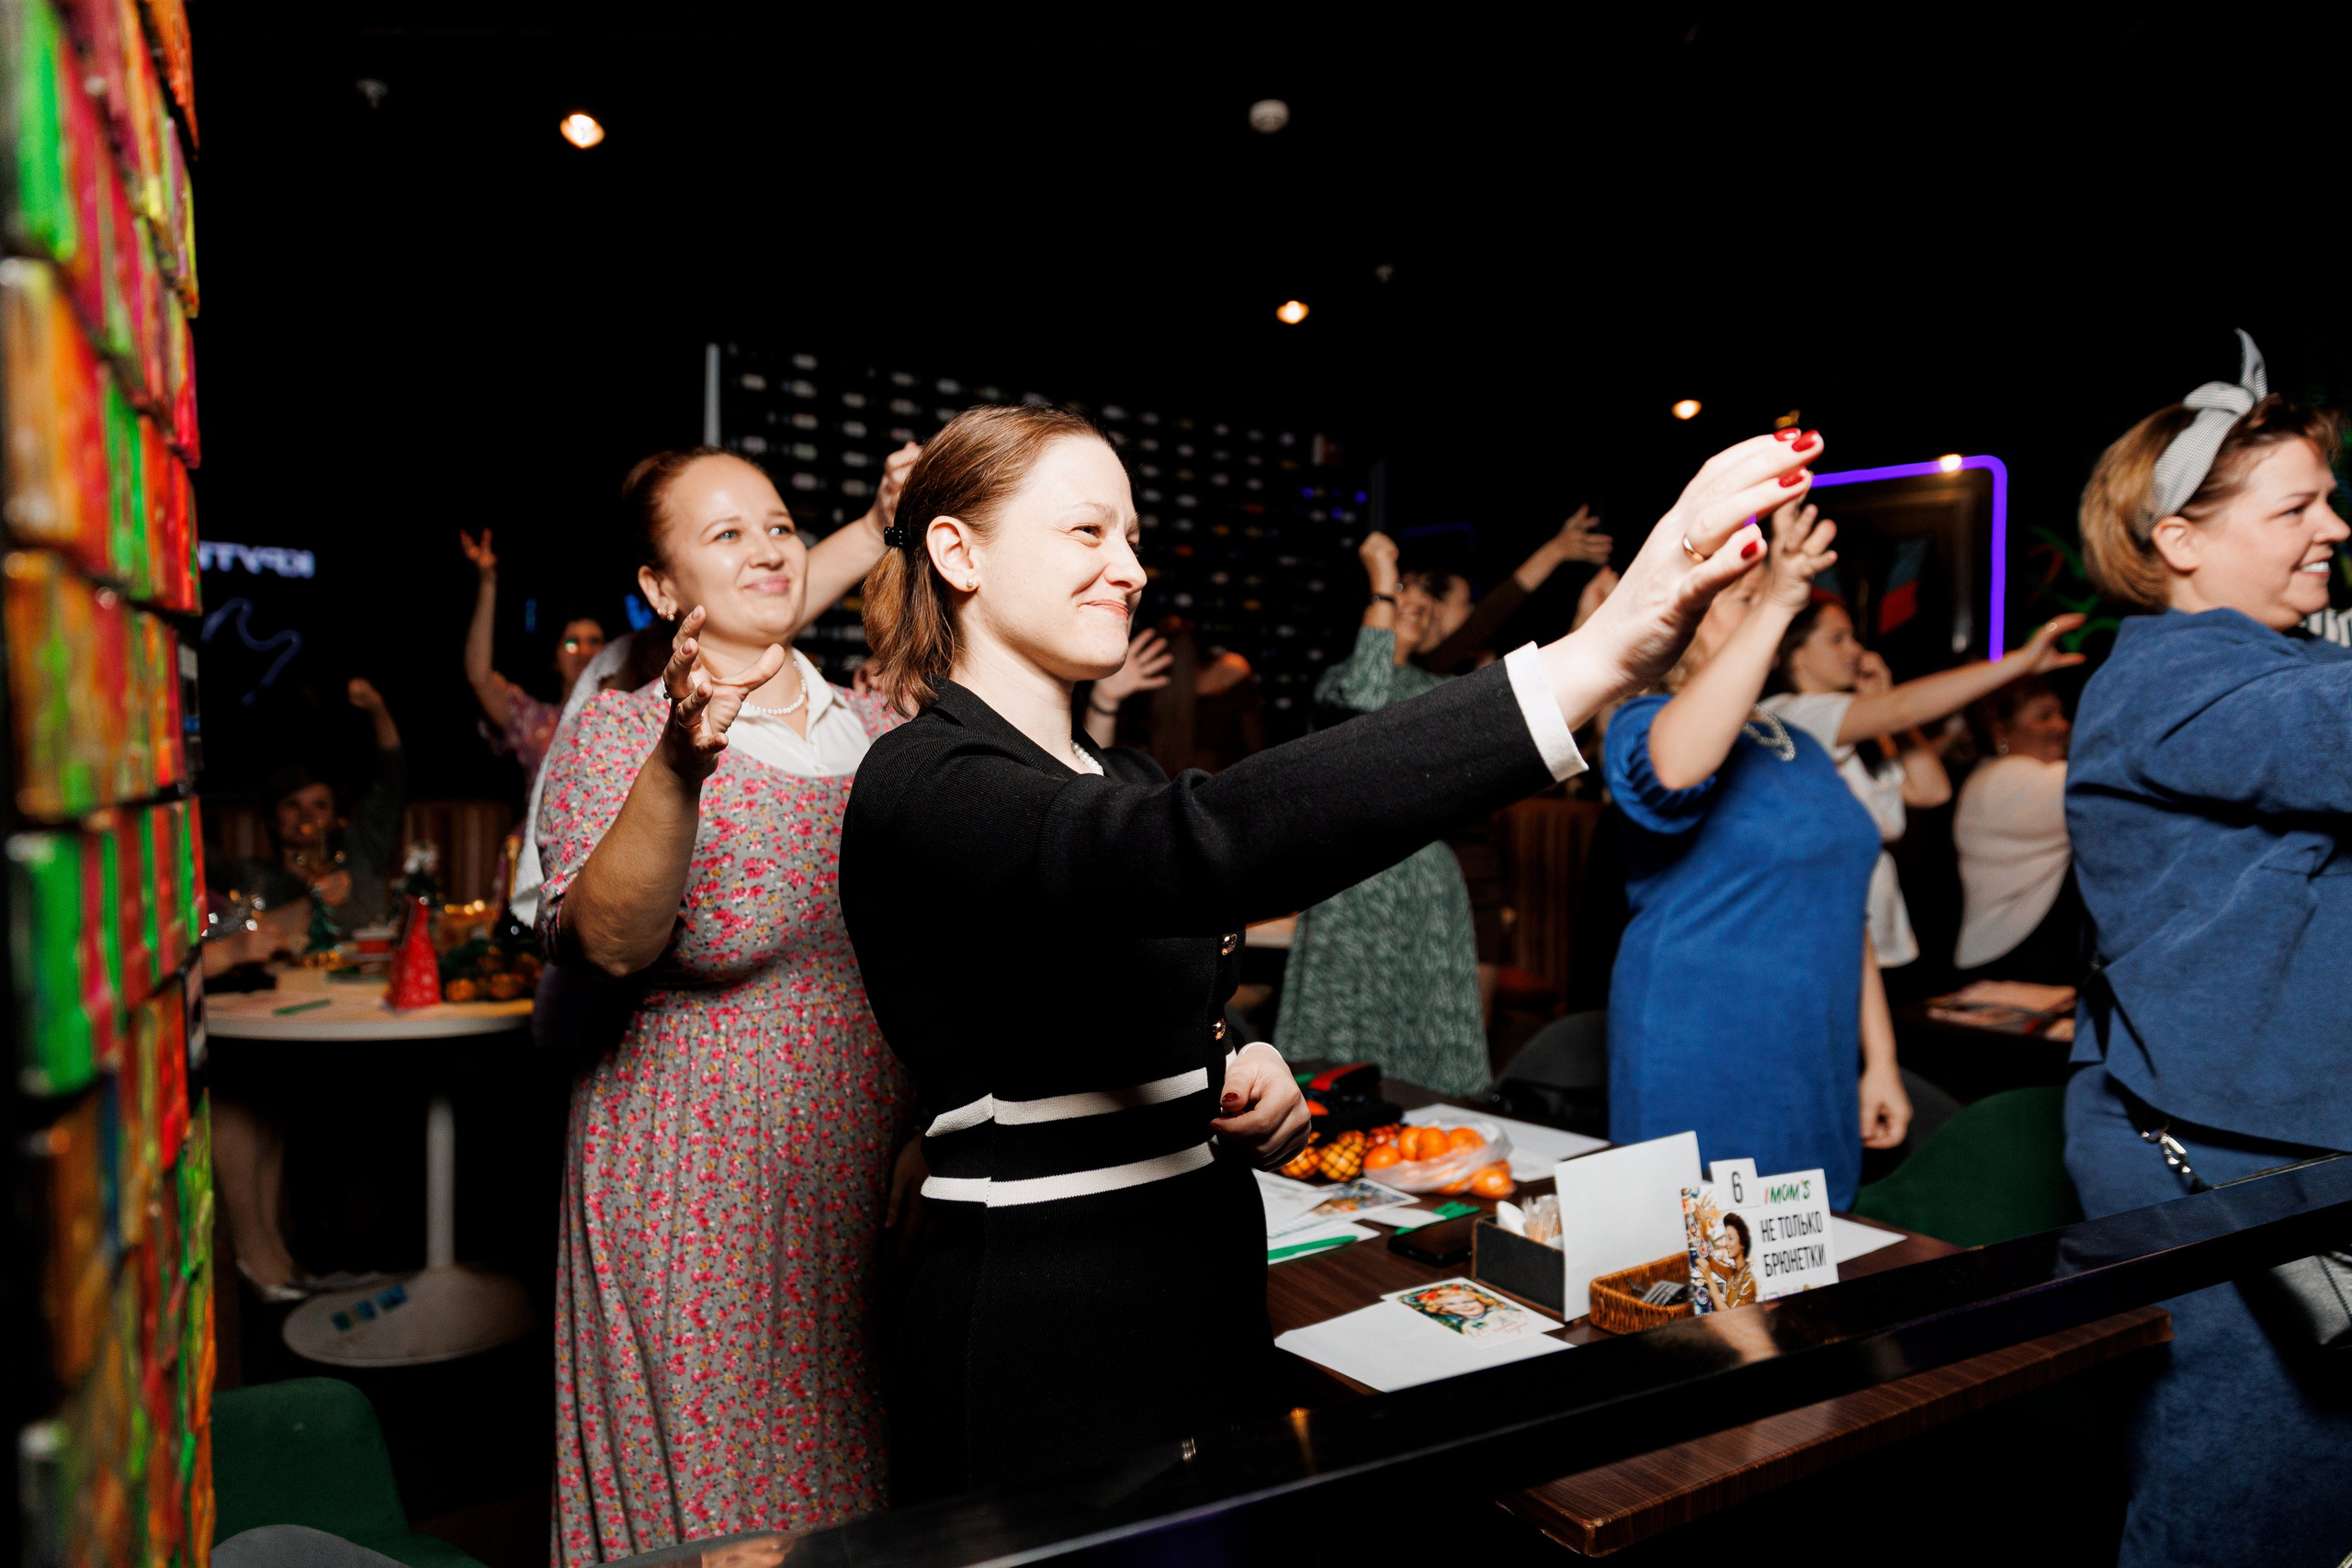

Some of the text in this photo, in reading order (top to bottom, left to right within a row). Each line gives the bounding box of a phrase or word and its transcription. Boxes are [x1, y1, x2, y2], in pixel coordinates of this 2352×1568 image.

[1732, 1171, 1743, 1203] 6
[1760, 1211, 1823, 1243] НЕ ТОЛЬКО
[1763, 1244, 1826, 1277] БРЮНЕТКИ
